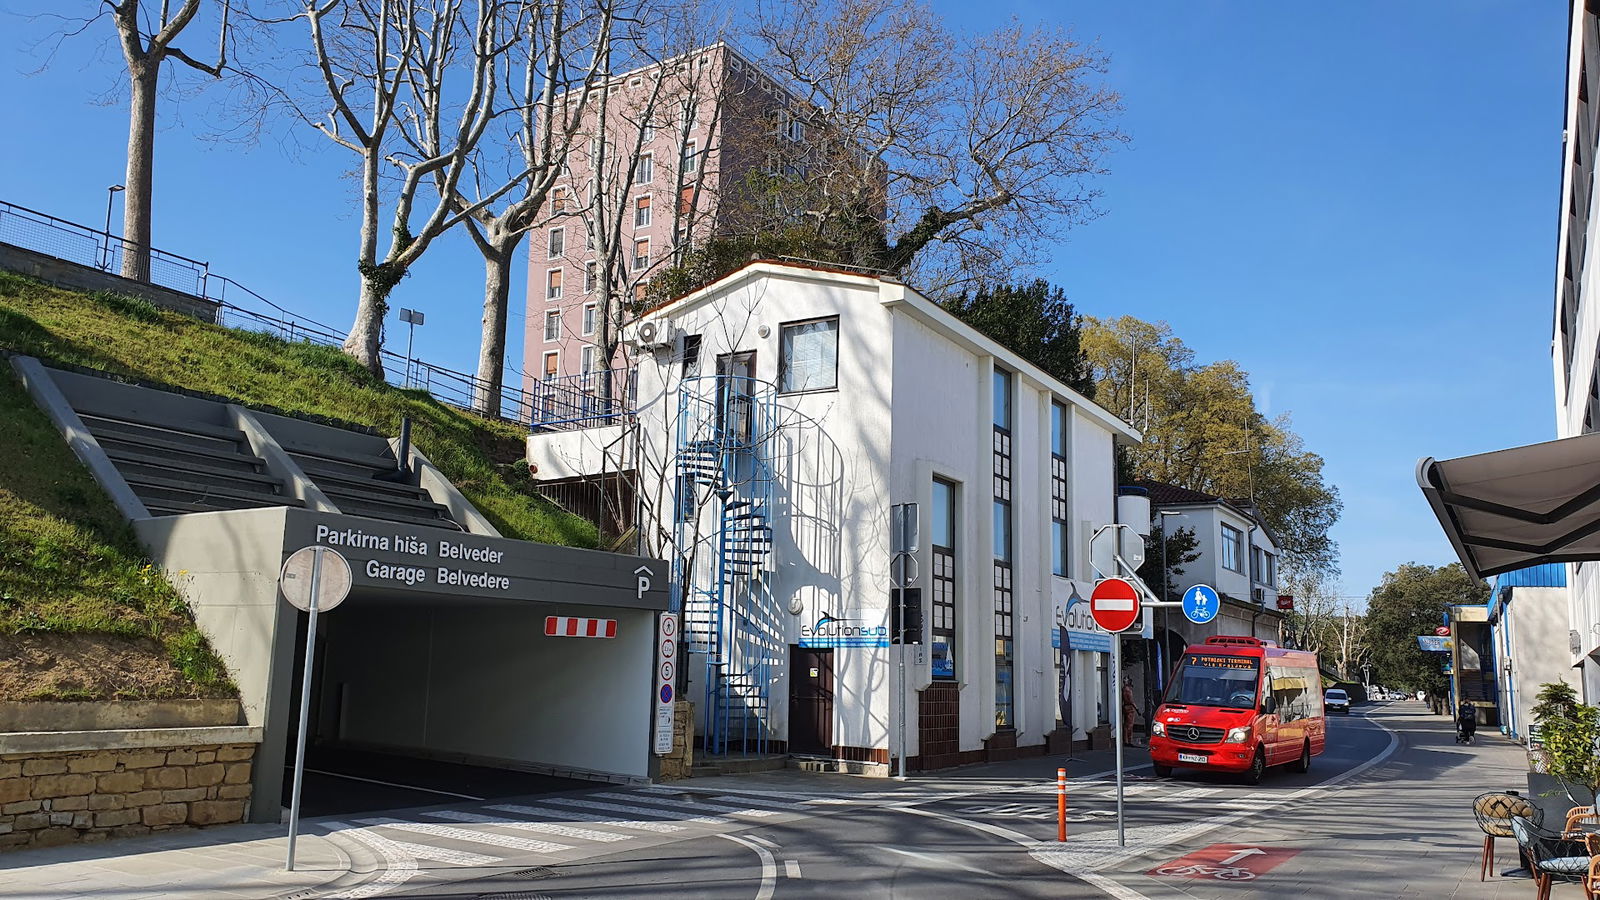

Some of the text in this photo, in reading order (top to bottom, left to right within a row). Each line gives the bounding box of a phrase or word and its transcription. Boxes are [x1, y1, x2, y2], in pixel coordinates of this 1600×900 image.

[316, 524, 504, 565] Parkirna hiša Belveder
[366, 559, 510, 591] Garage Belvedere
